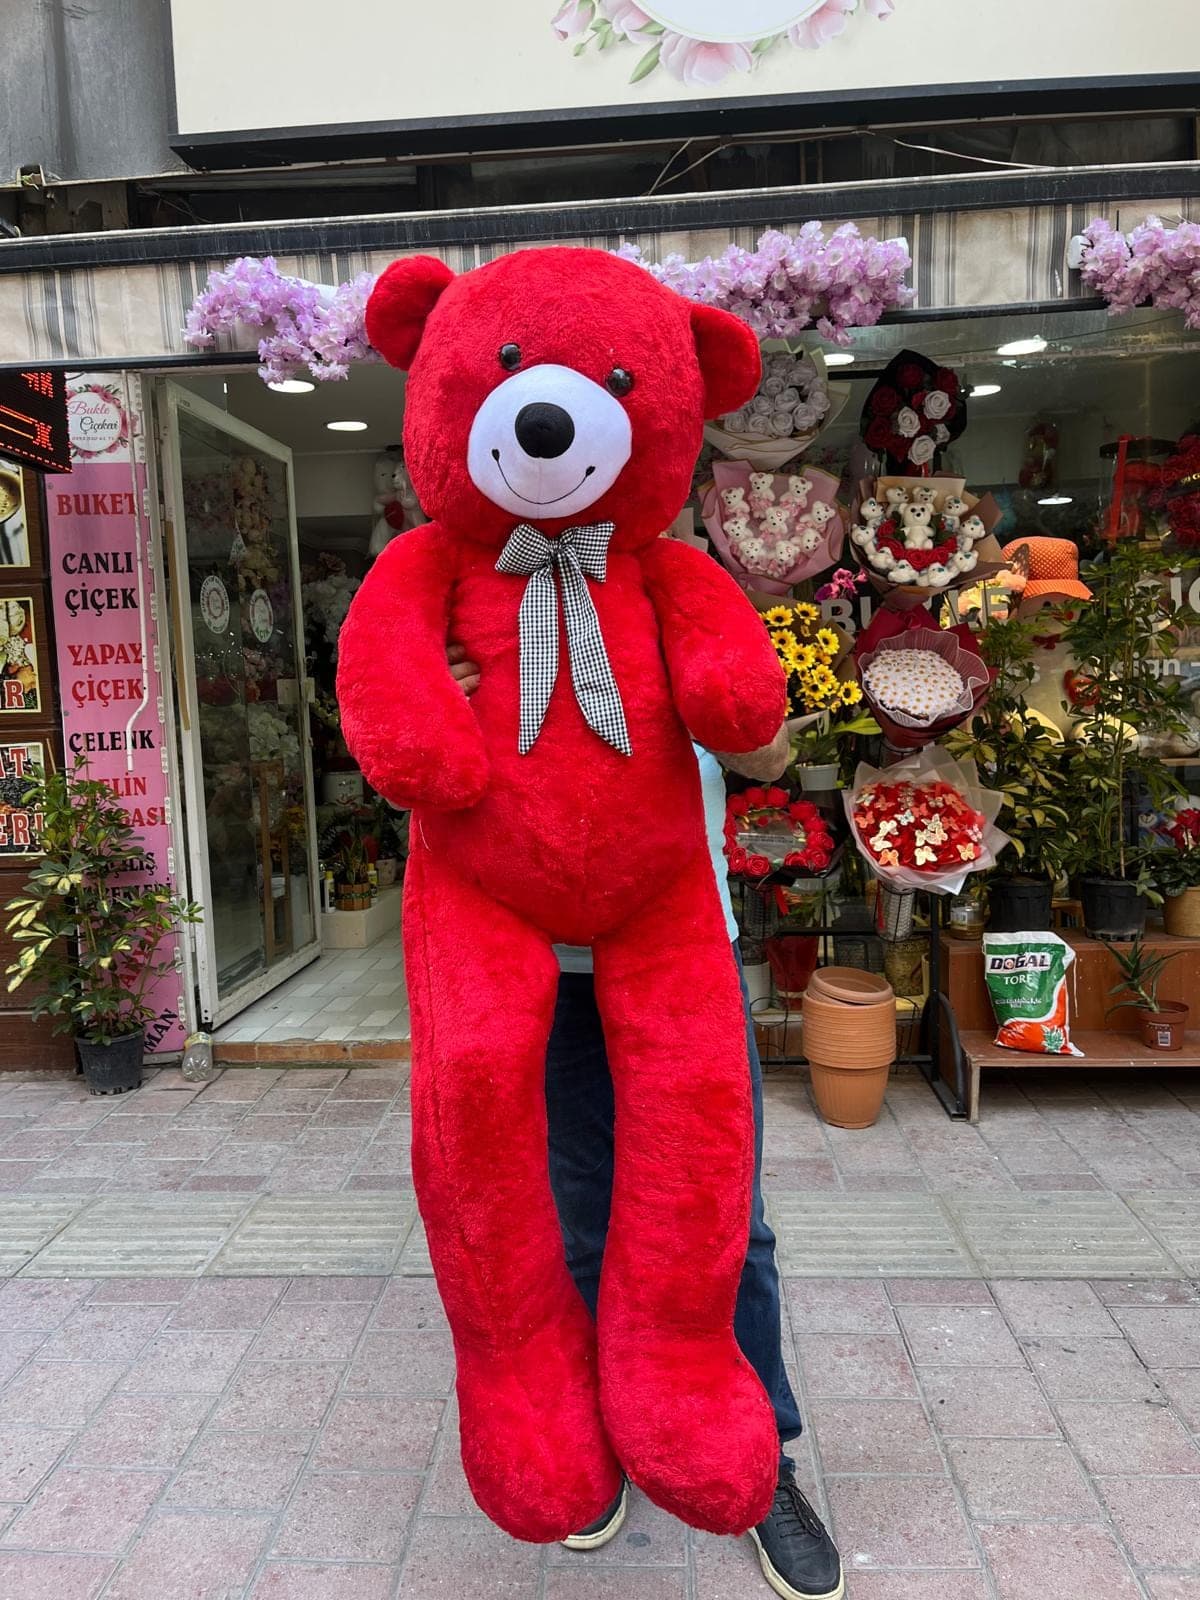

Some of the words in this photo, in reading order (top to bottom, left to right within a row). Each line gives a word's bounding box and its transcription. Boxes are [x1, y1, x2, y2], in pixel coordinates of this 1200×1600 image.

[56, 492, 137, 516] BUKET
[62, 552, 134, 575] CANLI
[65, 582, 138, 617] ÇİÇEK
[67, 643, 142, 666] YAPAY
[72, 674, 144, 709] ÇİÇEK
[69, 730, 155, 757] ÇELENK
[990, 953, 1050, 970] DOĞAL
